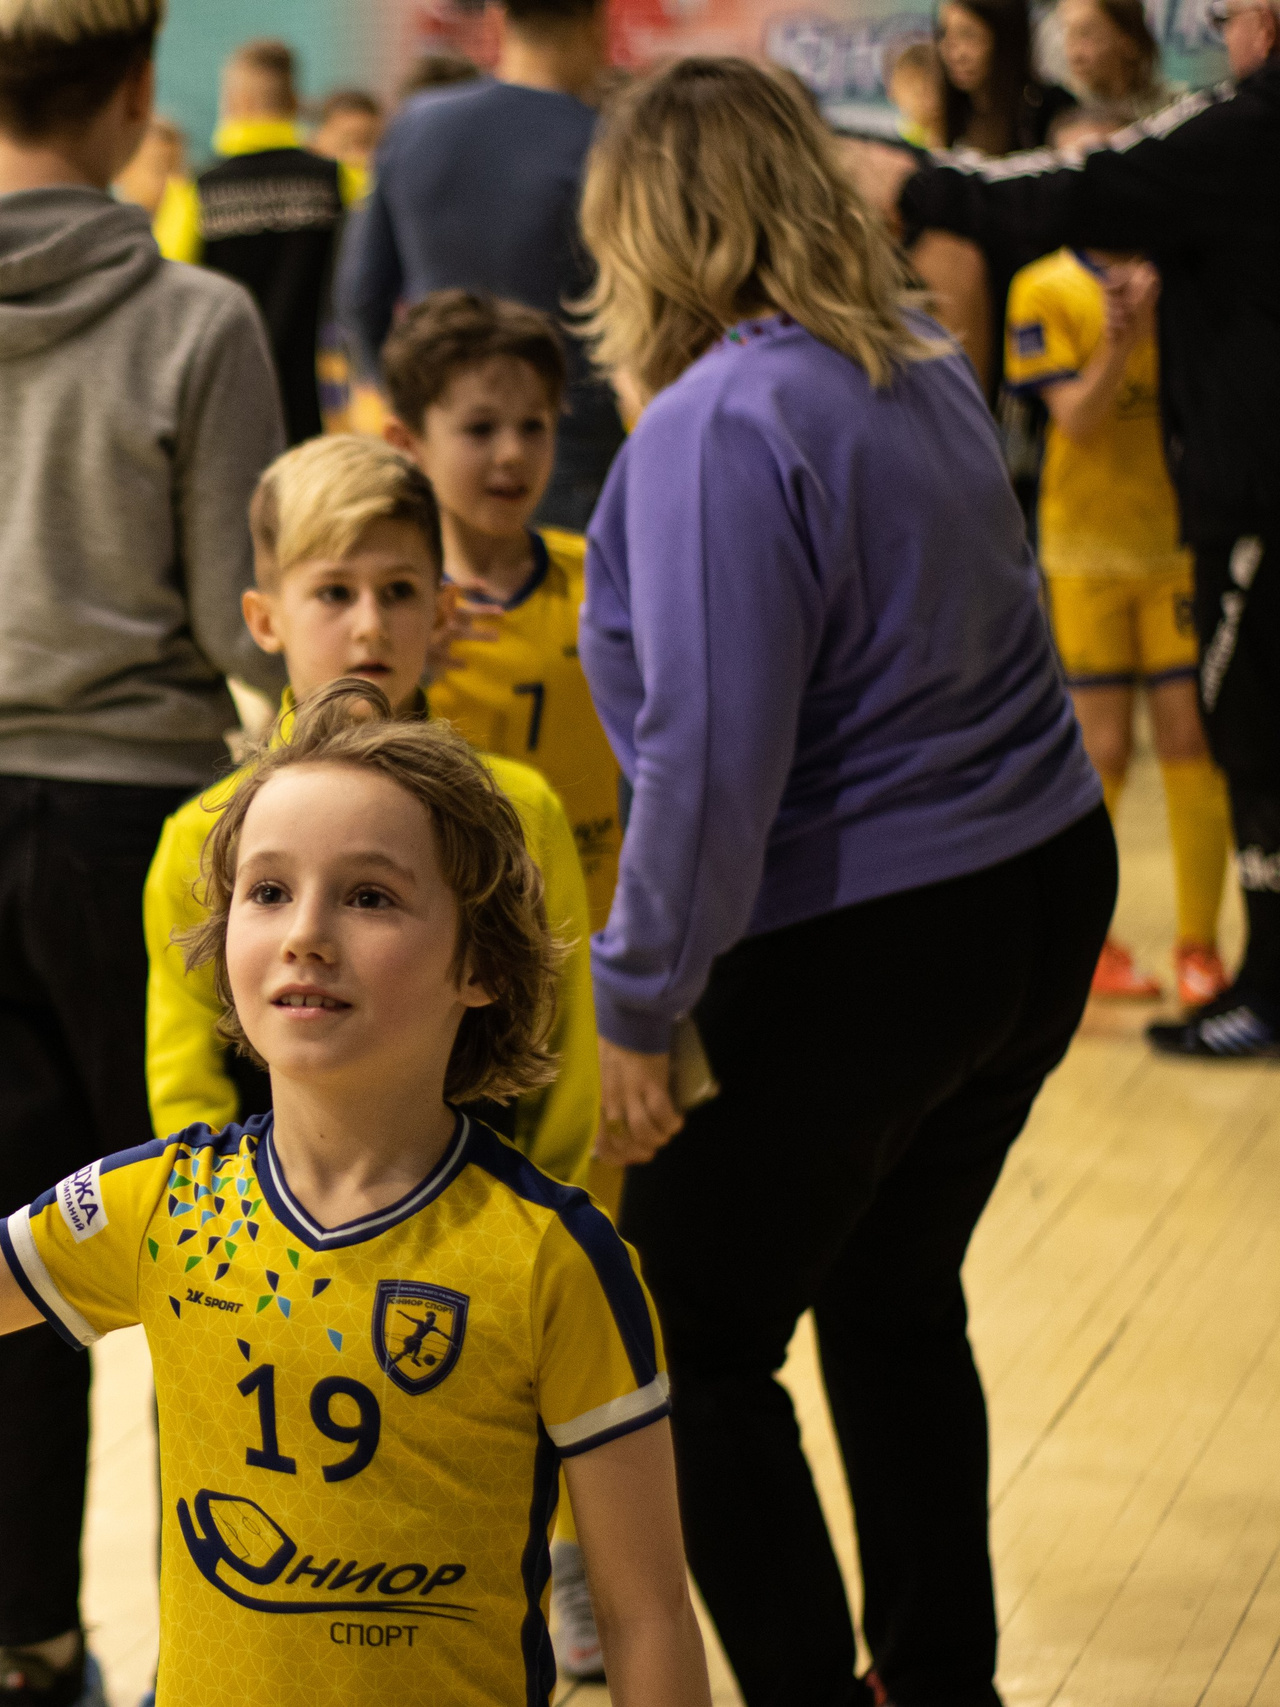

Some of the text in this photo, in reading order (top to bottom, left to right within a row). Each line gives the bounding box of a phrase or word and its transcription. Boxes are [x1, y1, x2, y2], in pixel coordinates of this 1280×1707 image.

[63, 1180, 86, 1231] ОМПАНИЙ
[72, 1164, 98, 1226] ДЖА
[204, 1296, 244, 1314] SPORT
[387, 1298, 454, 1316] ЮНИОР СПОРТ
[236, 1363, 381, 1483] 19
[330, 1621, 419, 1647] СПОРТ
